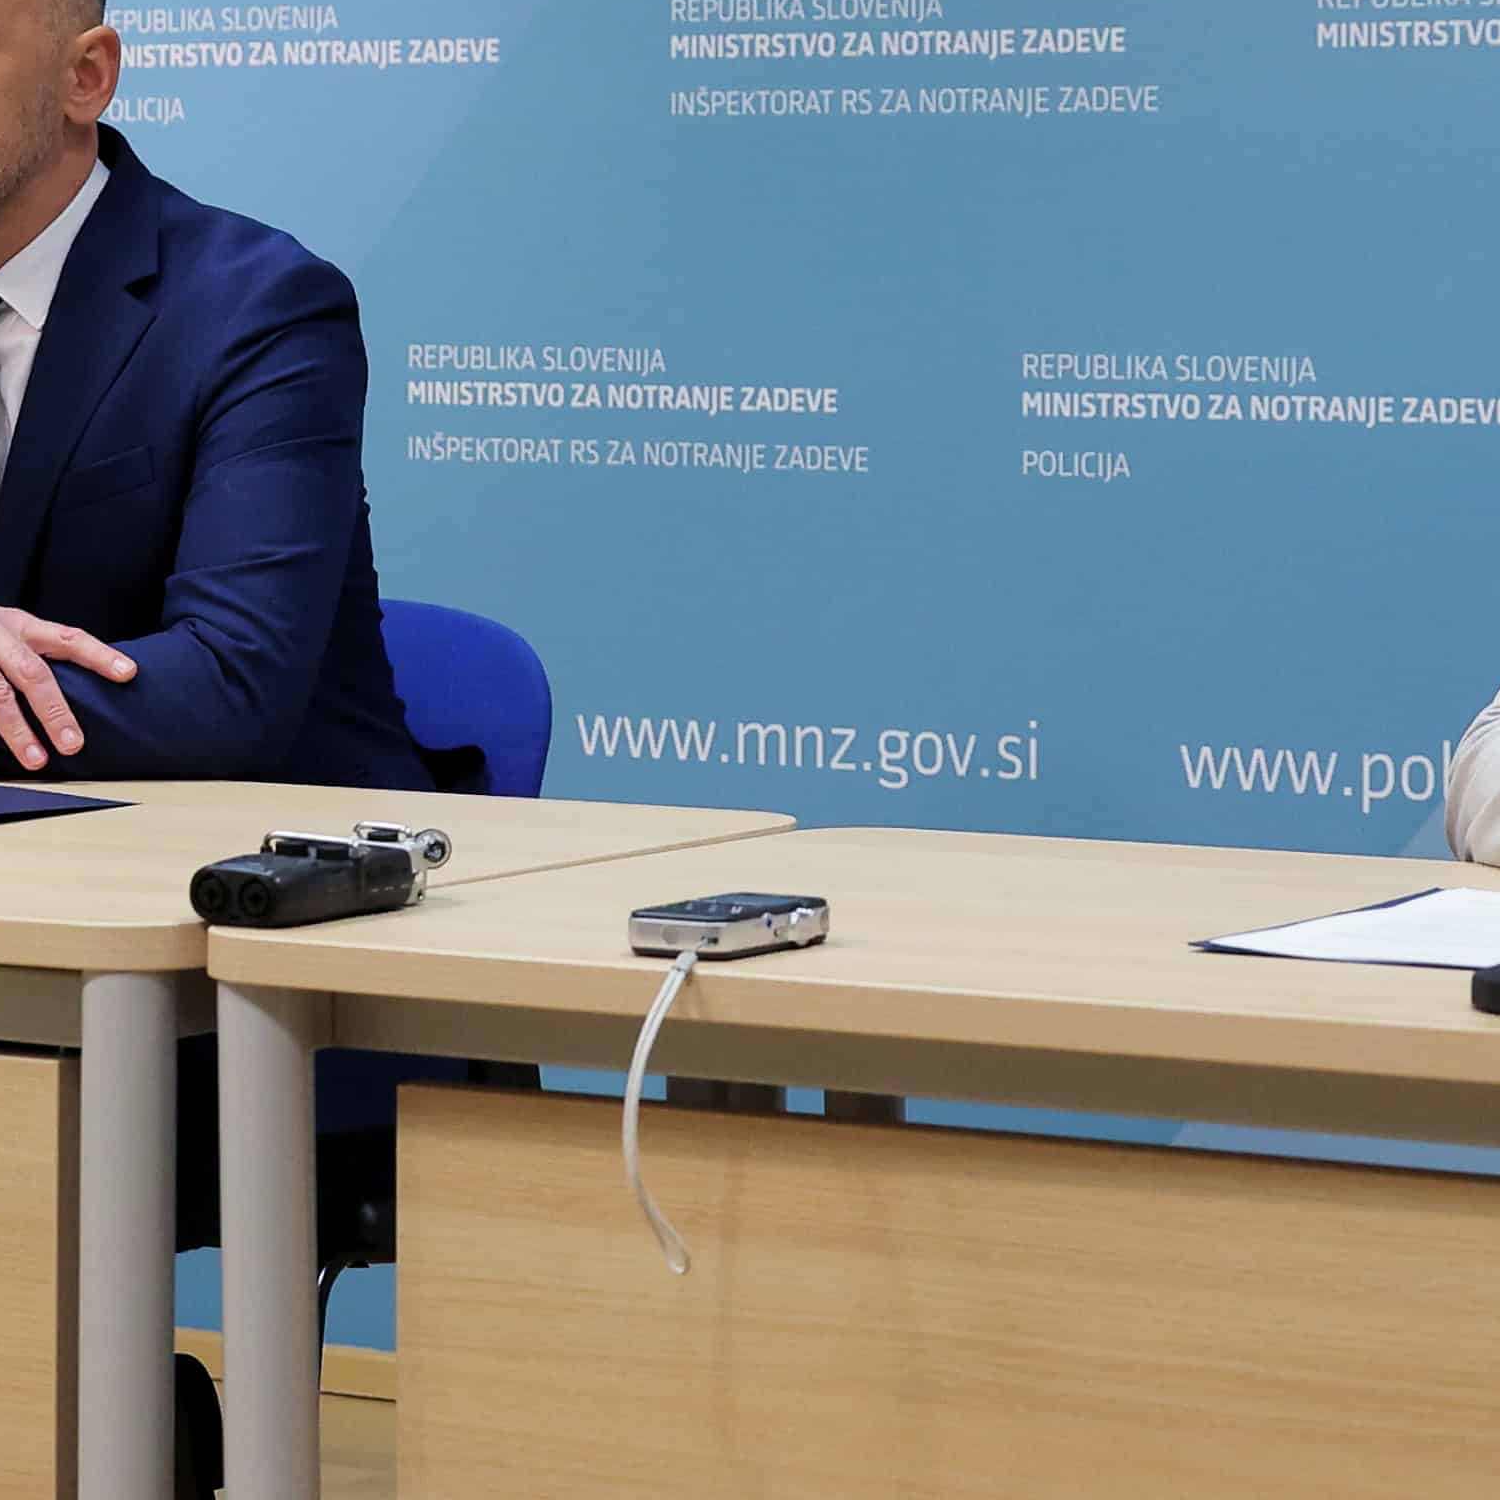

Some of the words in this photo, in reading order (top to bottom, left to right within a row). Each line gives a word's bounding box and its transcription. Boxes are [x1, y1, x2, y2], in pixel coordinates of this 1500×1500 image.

[221, 5, 338, 33] SLOVENIJA
[119, 40, 243, 69] NISTRSTVO
[248, 41, 278, 66] ZA
[283, 39, 402, 69] NOTRANJE
[408, 37, 500, 64] ZADEVE
[670, 32, 836, 59] MINISTRSTVO
[841, 31, 875, 57] ZA
[881, 29, 1015, 60] NOTRANJE
[1022, 27, 1126, 54] ZADEVE
[106, 96, 186, 124] OLICIJA
[671, 85, 834, 116] INŠPEKTORAT
[841, 88, 873, 116] RS
[879, 88, 912, 114] ZA
[919, 87, 1050, 118] NOTRANJE
[1057, 85, 1159, 113] ZADEVE
[408, 344, 537, 371] REPUBLIKA
[542, 346, 666, 377] SLOVENIJA
[1022, 353, 1168, 381] REPUBLIKA
[1175, 353, 1317, 388] SLOVENIJA
[408, 380, 565, 408] MINISTRSTVO
[571, 383, 602, 408] ZA
[607, 383, 734, 416] NOTRANJE
[740, 386, 838, 413] ZADEVE
[1022, 391, 1201, 420] MINISTRSTVO
[1207, 394, 1243, 421] ZA
[1250, 394, 1394, 429] NOTRANJE
[408, 431, 562, 464] INŠPEKTORAT
[570, 439, 600, 465] RS
[606, 440, 637, 466] ZA
[643, 441, 766, 474] NOTRANJE
[774, 444, 869, 472] ZADEVE
[1022, 449, 1131, 483] POLICIJA
[575, 713, 1039, 789] www.mnz.gov.si
[1179, 739, 1452, 815] www.pol
